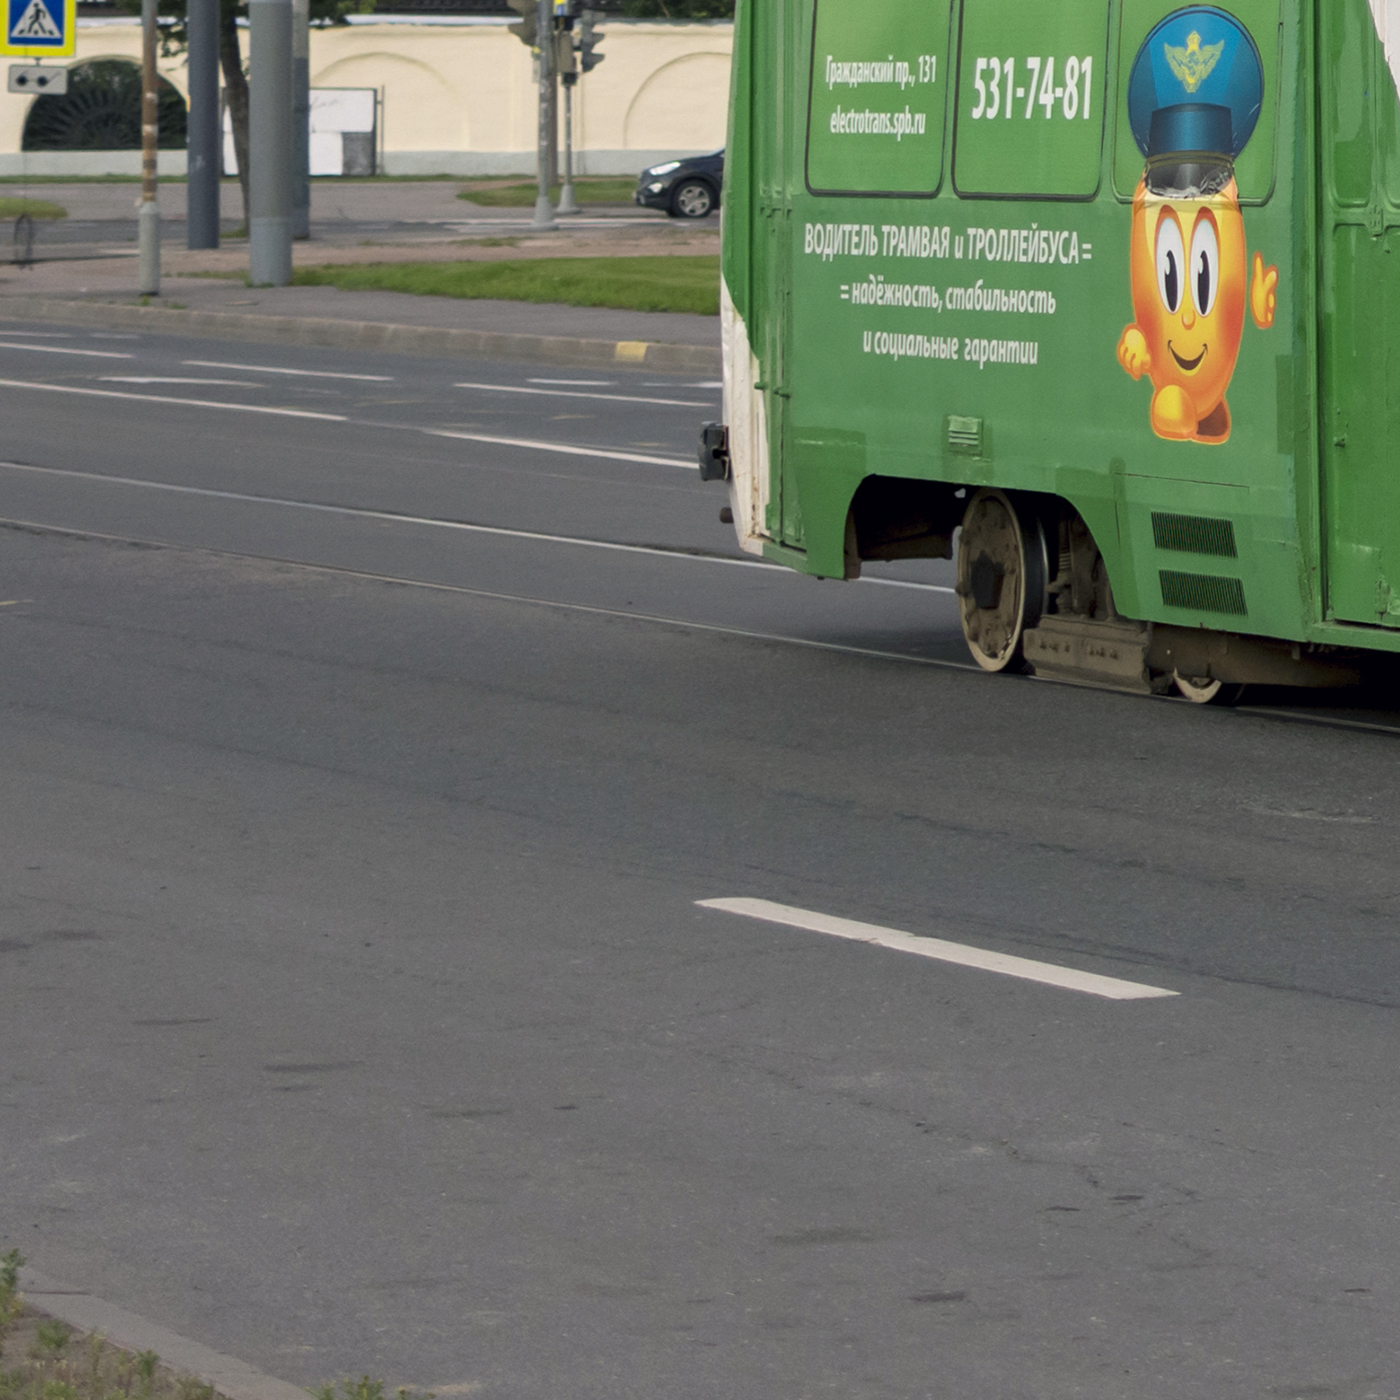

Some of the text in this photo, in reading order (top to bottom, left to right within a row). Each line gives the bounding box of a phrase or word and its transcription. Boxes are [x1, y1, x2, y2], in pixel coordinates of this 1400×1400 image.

[825, 55, 937, 90] Гражданский пр., 131
[971, 55, 1093, 120] 531-74-81
[829, 105, 926, 141] electrotrans.spb.ru
[804, 222, 879, 262] ВОДИТЕЛЬ
[881, 225, 950, 259] ТРАМВАЯ
[954, 235, 964, 259] и
[967, 222, 1080, 264] ТРОЛЛЕЙБУСА
[851, 273, 943, 313] надёжность,
[945, 279, 1057, 314] стабильность
[863, 331, 1039, 370] и социальные гарантии
